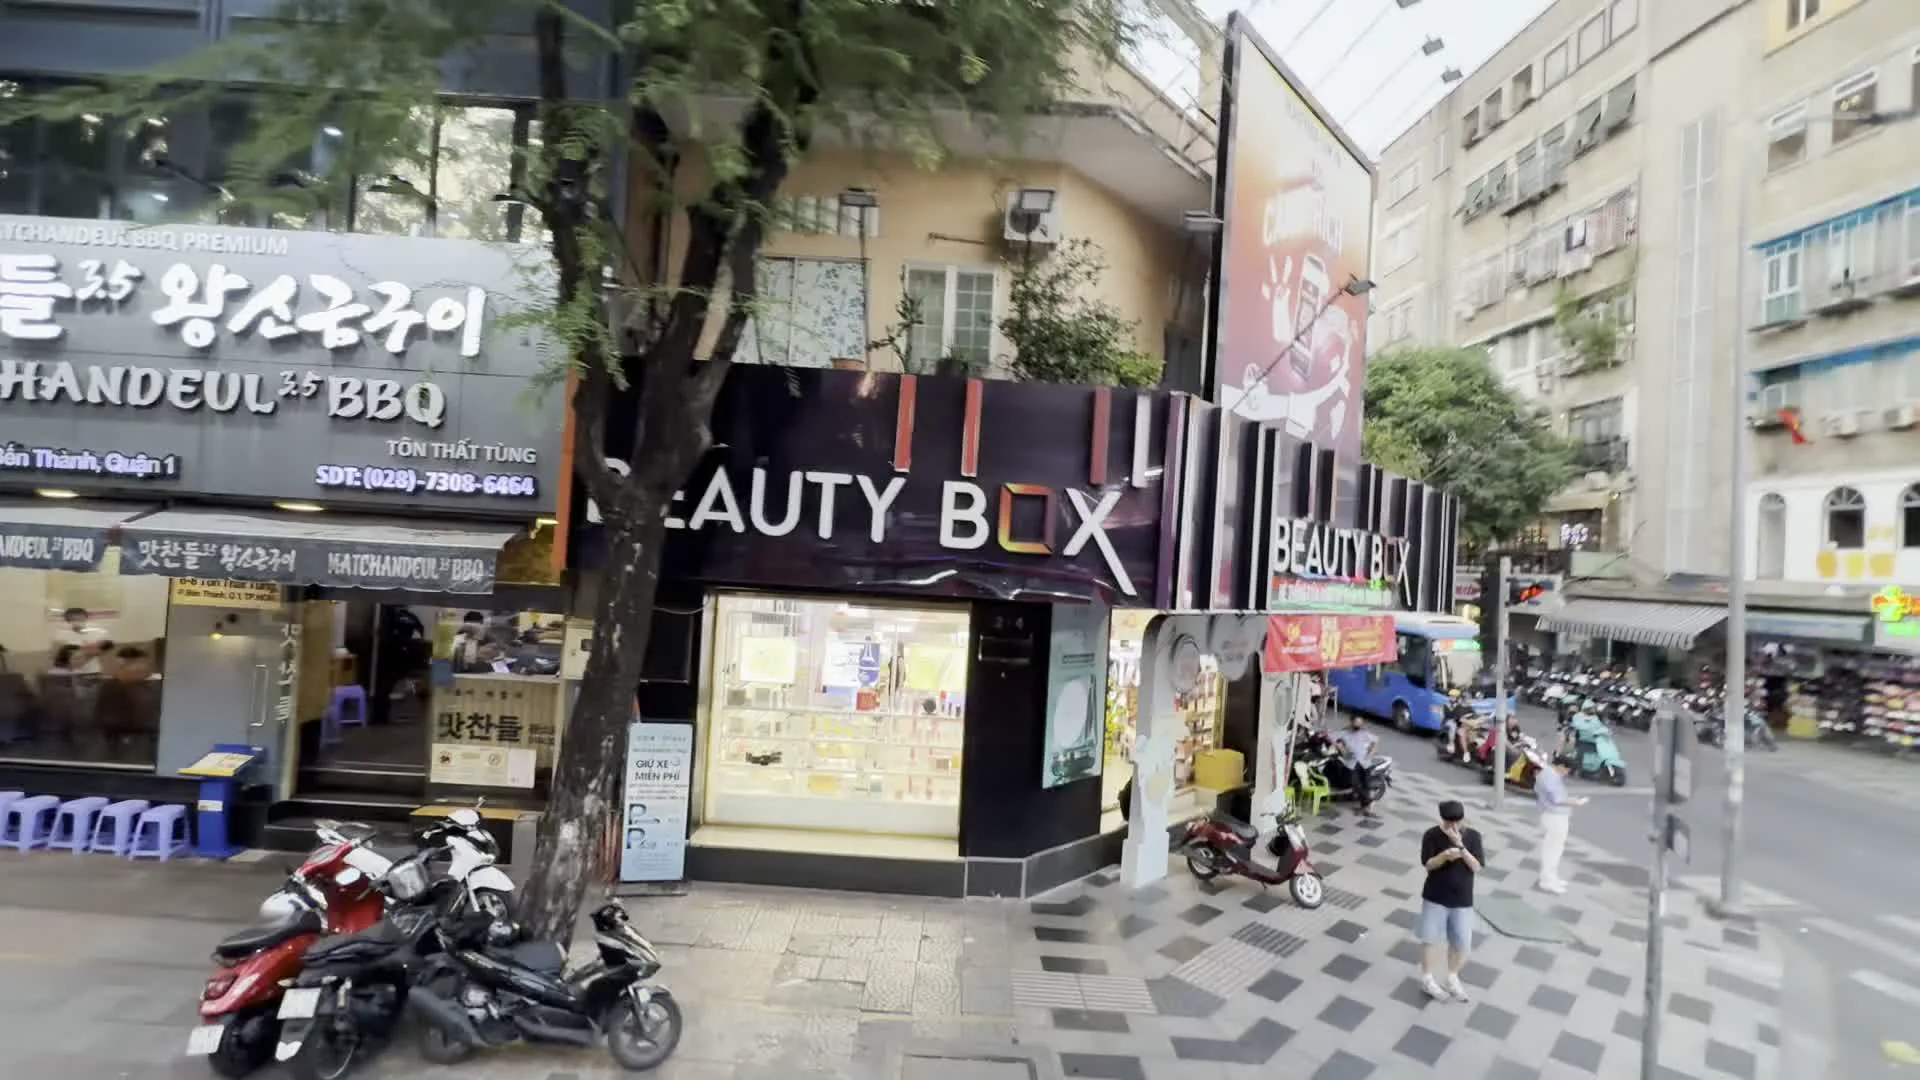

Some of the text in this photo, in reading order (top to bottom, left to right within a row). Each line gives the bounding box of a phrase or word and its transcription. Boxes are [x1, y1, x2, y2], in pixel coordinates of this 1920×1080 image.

[183, 231, 289, 256] PREMIUM
[75, 258, 144, 301] 3.5
[277, 369, 325, 398] 3.5
[328, 375, 446, 428] BBQ
[104, 451, 161, 478] Quận
[163, 455, 176, 475] 1
[387, 436, 537, 464] TÔN THẤT TÙNG
[363, 466, 536, 497] (028)-7308-6464
[939, 480, 1137, 597] BOX
[327, 552, 440, 580] MATCHANDEUL
[451, 558, 485, 582] BBQ
[1274, 518, 1413, 607] BEAUTY BOX
[437, 711, 523, 742] 맛찬들
[656, 759, 669, 769] XE
